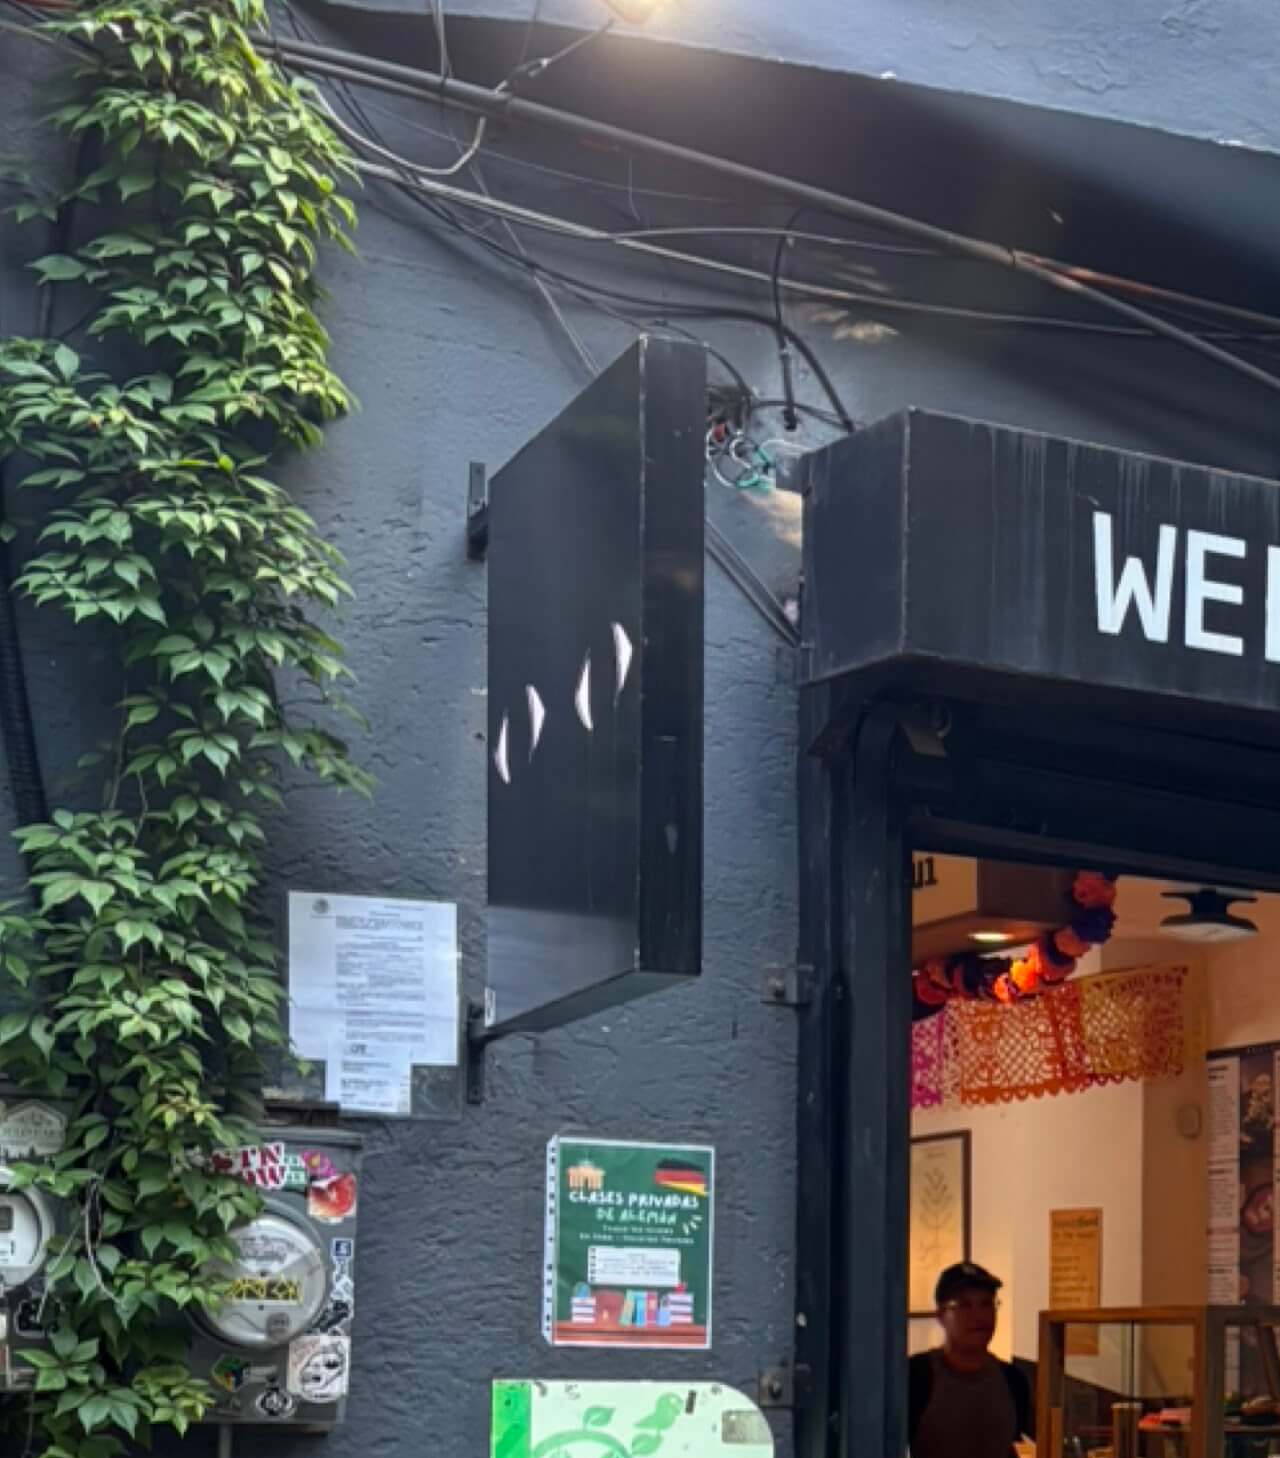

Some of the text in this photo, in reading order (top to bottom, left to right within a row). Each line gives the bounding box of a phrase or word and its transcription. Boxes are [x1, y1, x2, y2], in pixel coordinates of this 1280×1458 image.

[569, 1191, 699, 1209] CLASES PRIVADAS
[596, 1207, 614, 1221] DE
